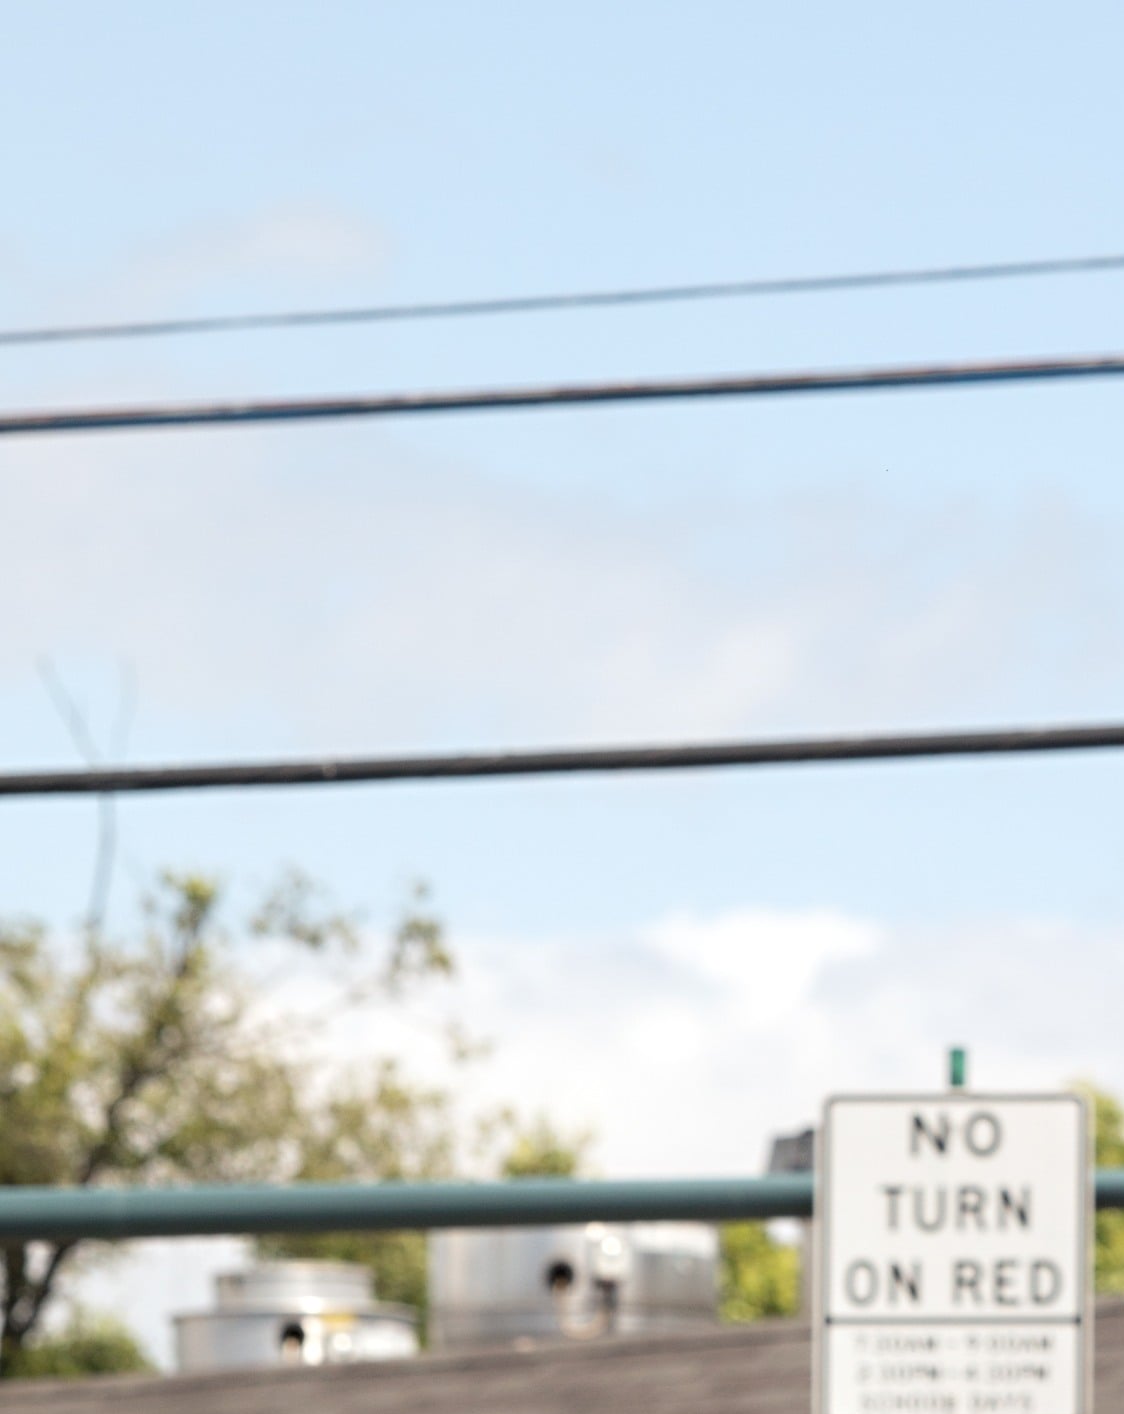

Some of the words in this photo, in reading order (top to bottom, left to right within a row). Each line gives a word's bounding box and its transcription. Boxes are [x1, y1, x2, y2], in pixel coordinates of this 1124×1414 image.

[909, 1110, 1003, 1158] NO
[881, 1184, 1032, 1233] TURN
[845, 1258, 922, 1308] ON
[951, 1258, 1063, 1308] RED
